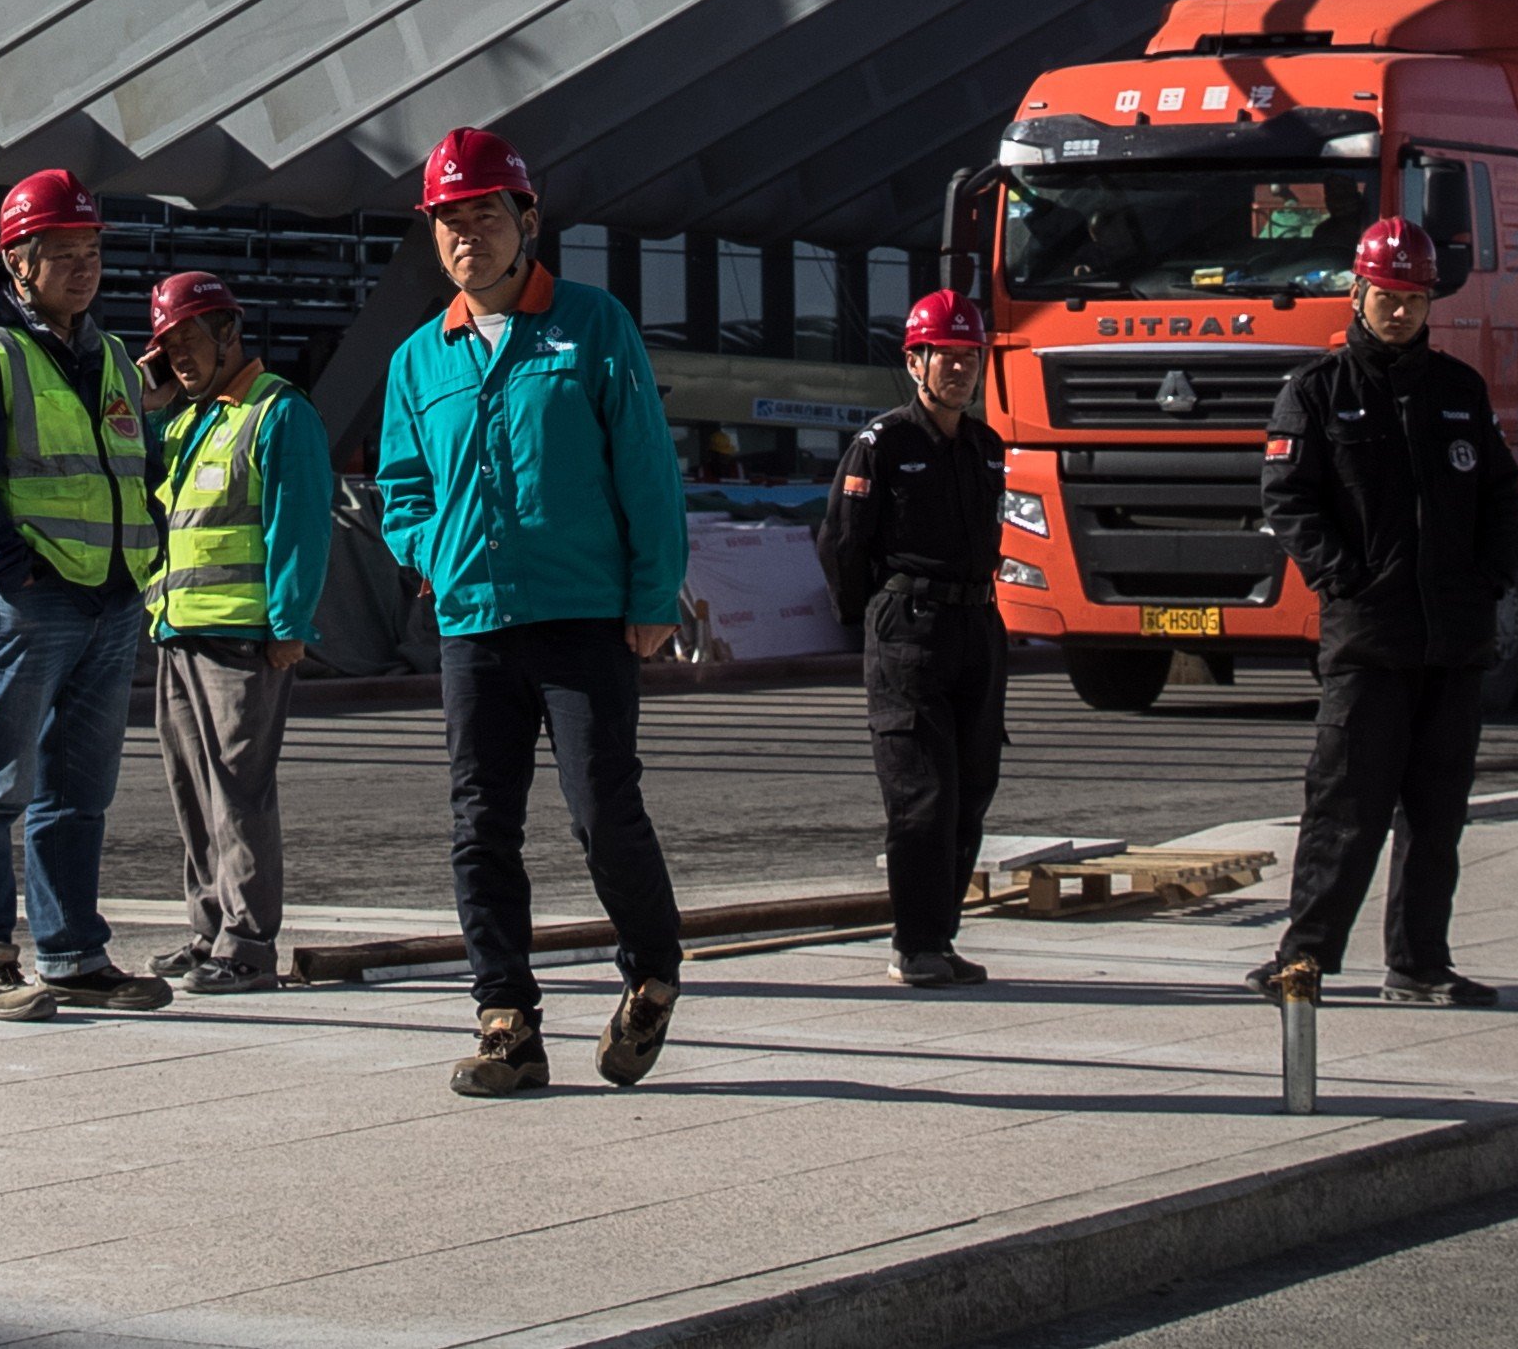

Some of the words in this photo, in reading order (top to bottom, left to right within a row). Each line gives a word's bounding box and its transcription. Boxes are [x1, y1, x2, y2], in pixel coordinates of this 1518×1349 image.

[1114, 85, 1275, 113] 中国重汽
[1097, 315, 1255, 337] SITRAK
